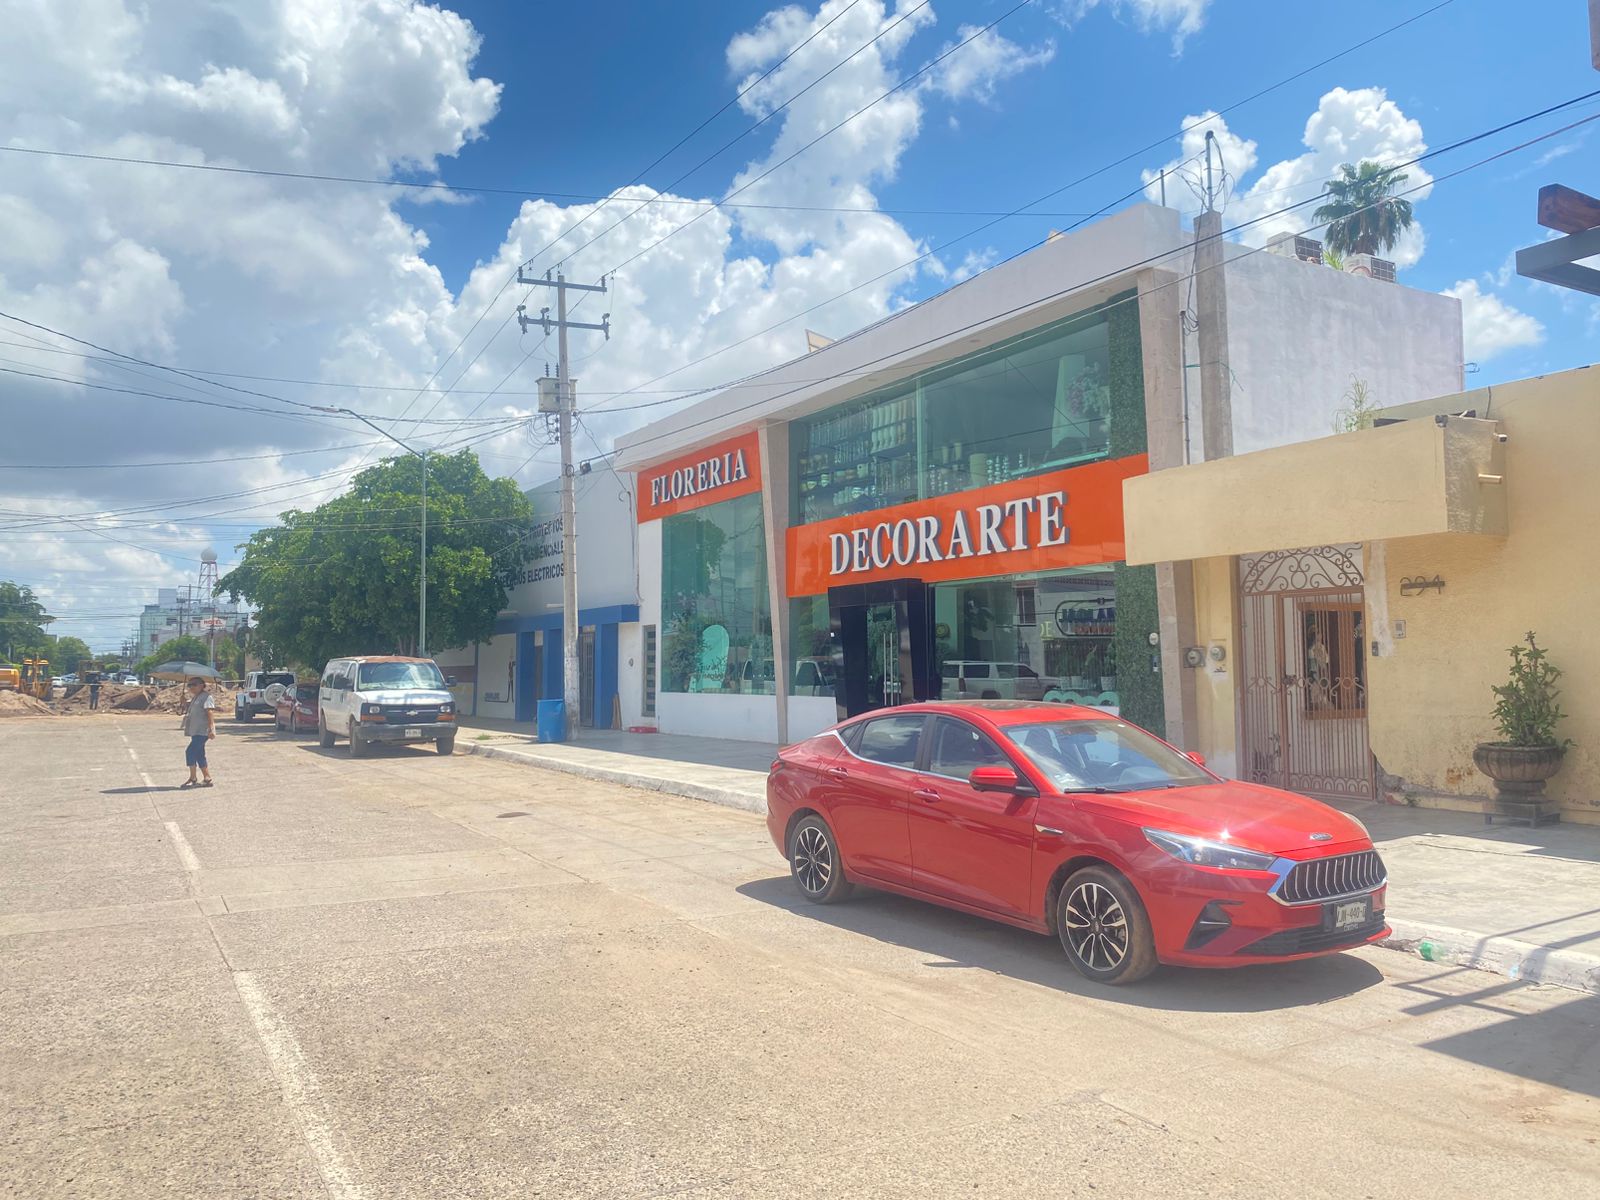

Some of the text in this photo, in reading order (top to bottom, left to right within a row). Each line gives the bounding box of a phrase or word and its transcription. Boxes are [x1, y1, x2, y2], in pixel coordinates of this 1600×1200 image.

[651, 448, 748, 506] FLORERIA
[829, 490, 1068, 575] DECORARTE
[528, 563, 564, 583] ELECTRICOS
